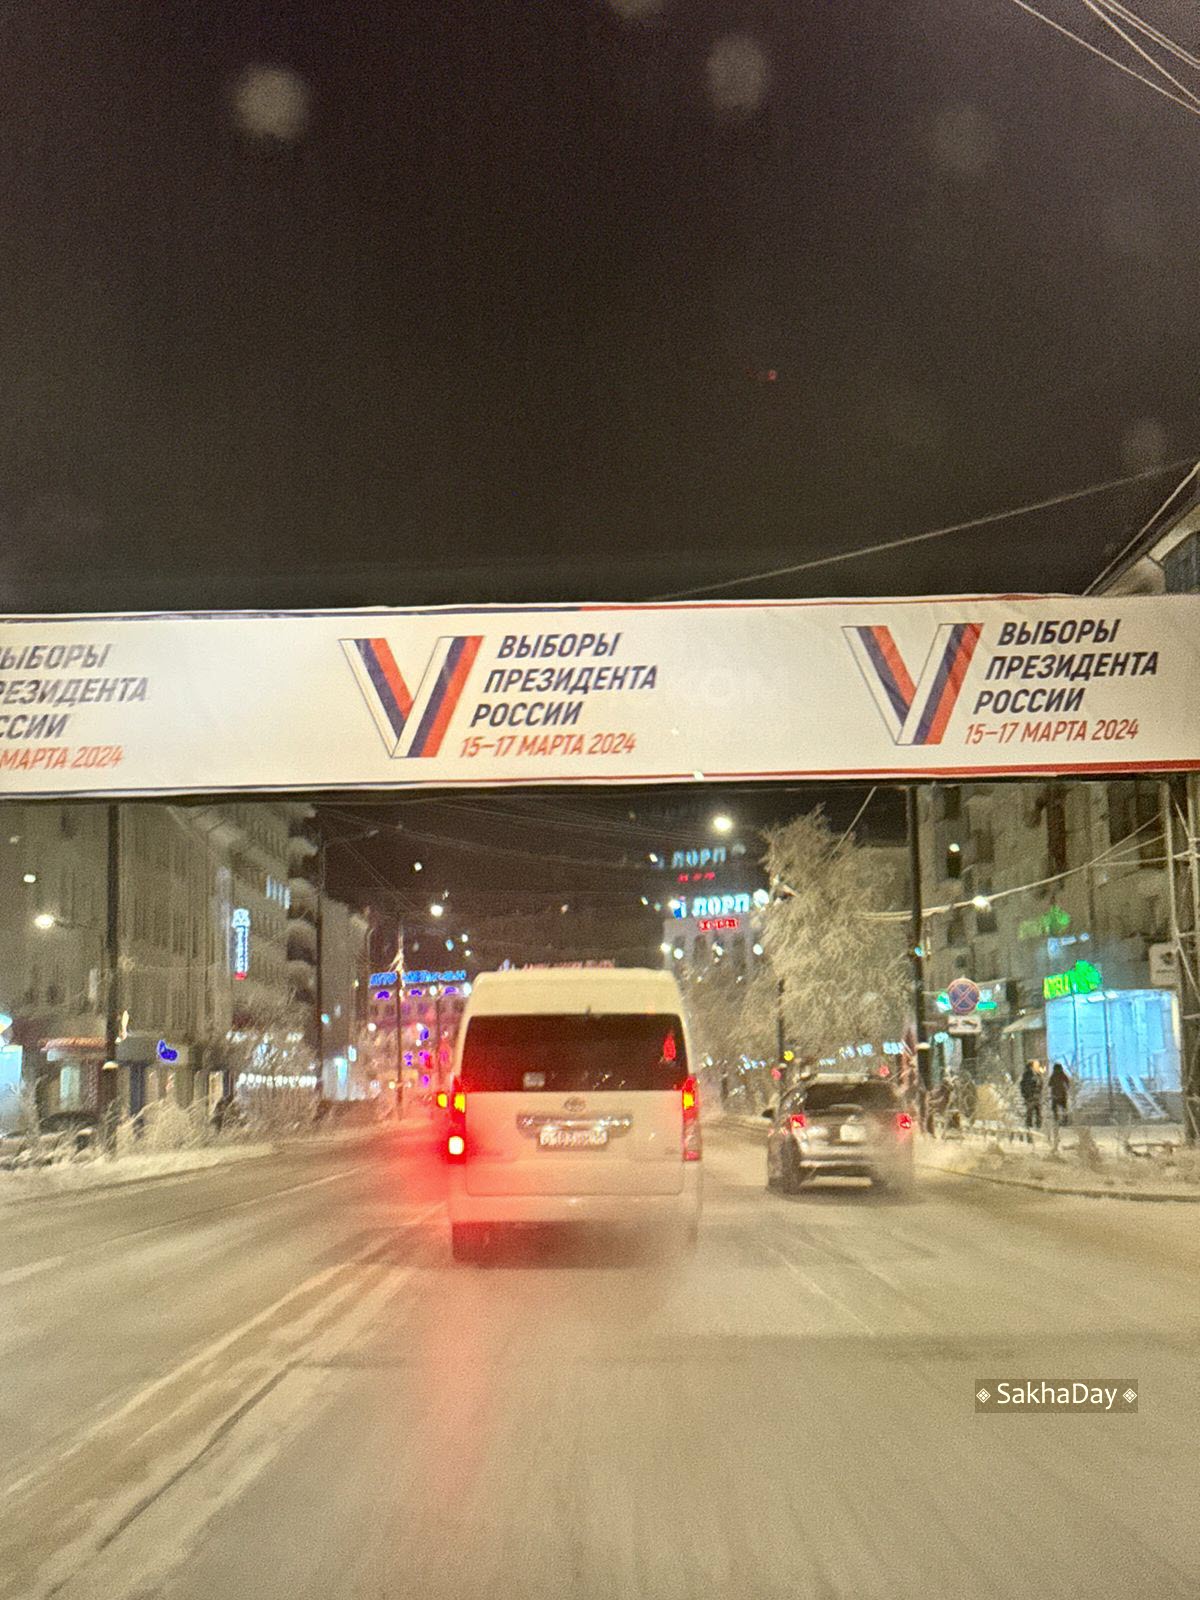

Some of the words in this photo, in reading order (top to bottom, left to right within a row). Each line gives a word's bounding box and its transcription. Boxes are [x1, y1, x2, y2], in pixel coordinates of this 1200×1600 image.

[497, 632, 623, 658] ВЫБОРЫ
[997, 619, 1121, 646] ВЫБОРЫ
[0, 644, 111, 670] ЫБОРЫ
[985, 651, 1160, 682] ПРЕЗИДЕНТА
[0, 677, 149, 707] ЕЗИДЕНТА
[483, 665, 658, 695] ПРЕЗИДЕНТА
[470, 701, 583, 728] РОССИИ
[973, 687, 1086, 715] РОССИИ
[1020, 720, 1087, 743] МАРТА
[1090, 718, 1139, 741] 2024
[0, 747, 69, 770] МАРТА
[70, 746, 123, 769] 2024
[516, 734, 585, 757] МАРТА
[587, 732, 637, 755] 2024
